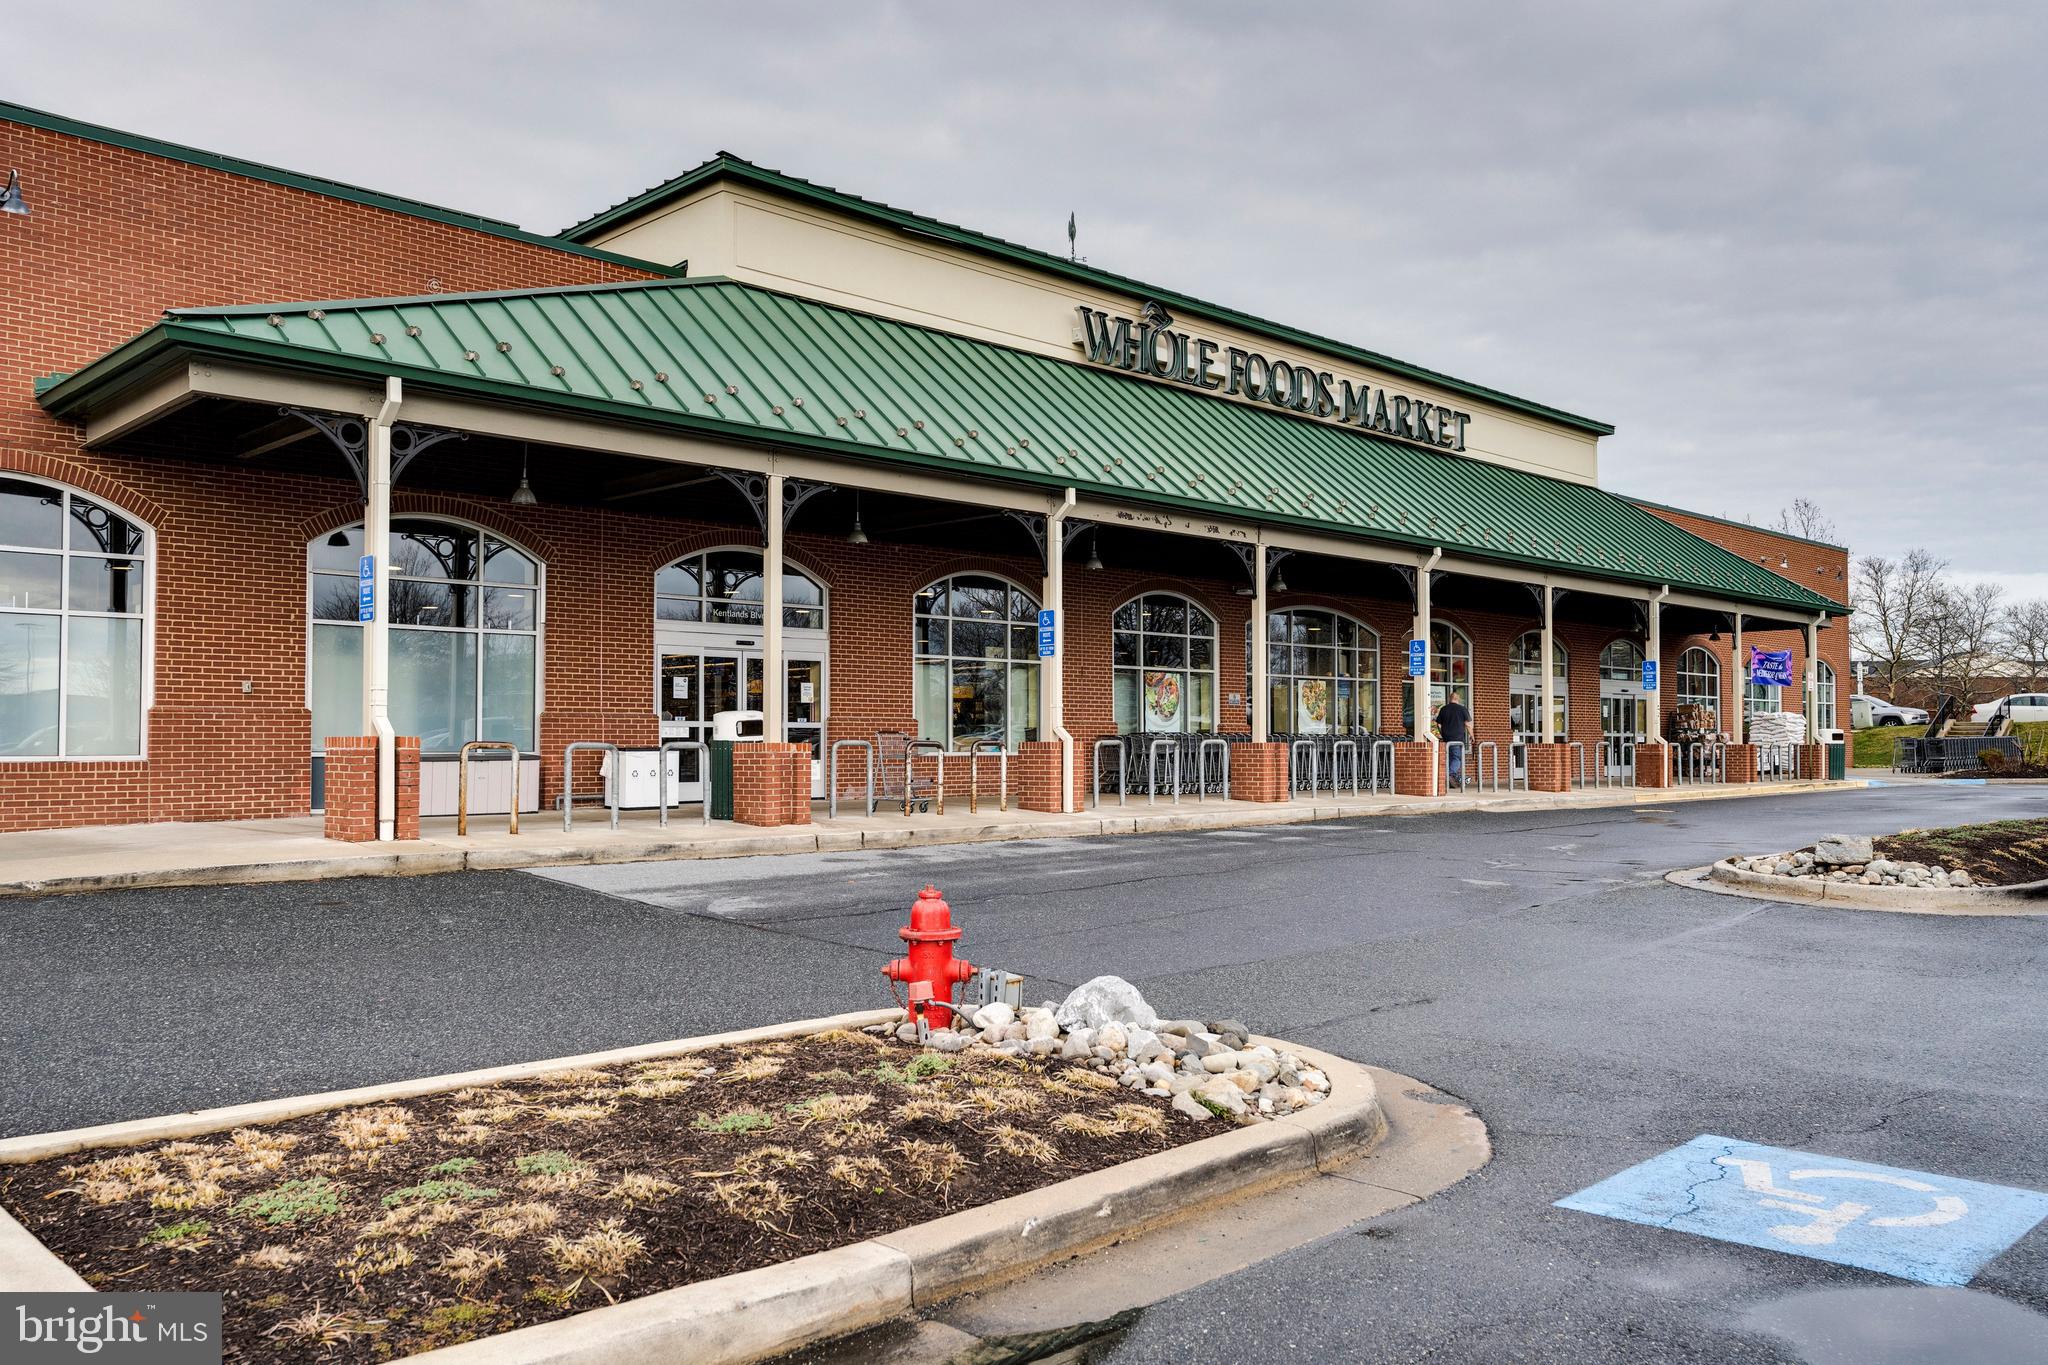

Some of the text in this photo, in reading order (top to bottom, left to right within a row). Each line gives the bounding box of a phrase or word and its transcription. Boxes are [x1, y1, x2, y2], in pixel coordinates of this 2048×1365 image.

[1074, 301, 1471, 452] WHOLE FOODS MARKET
[713, 609, 749, 618] Kentlands
